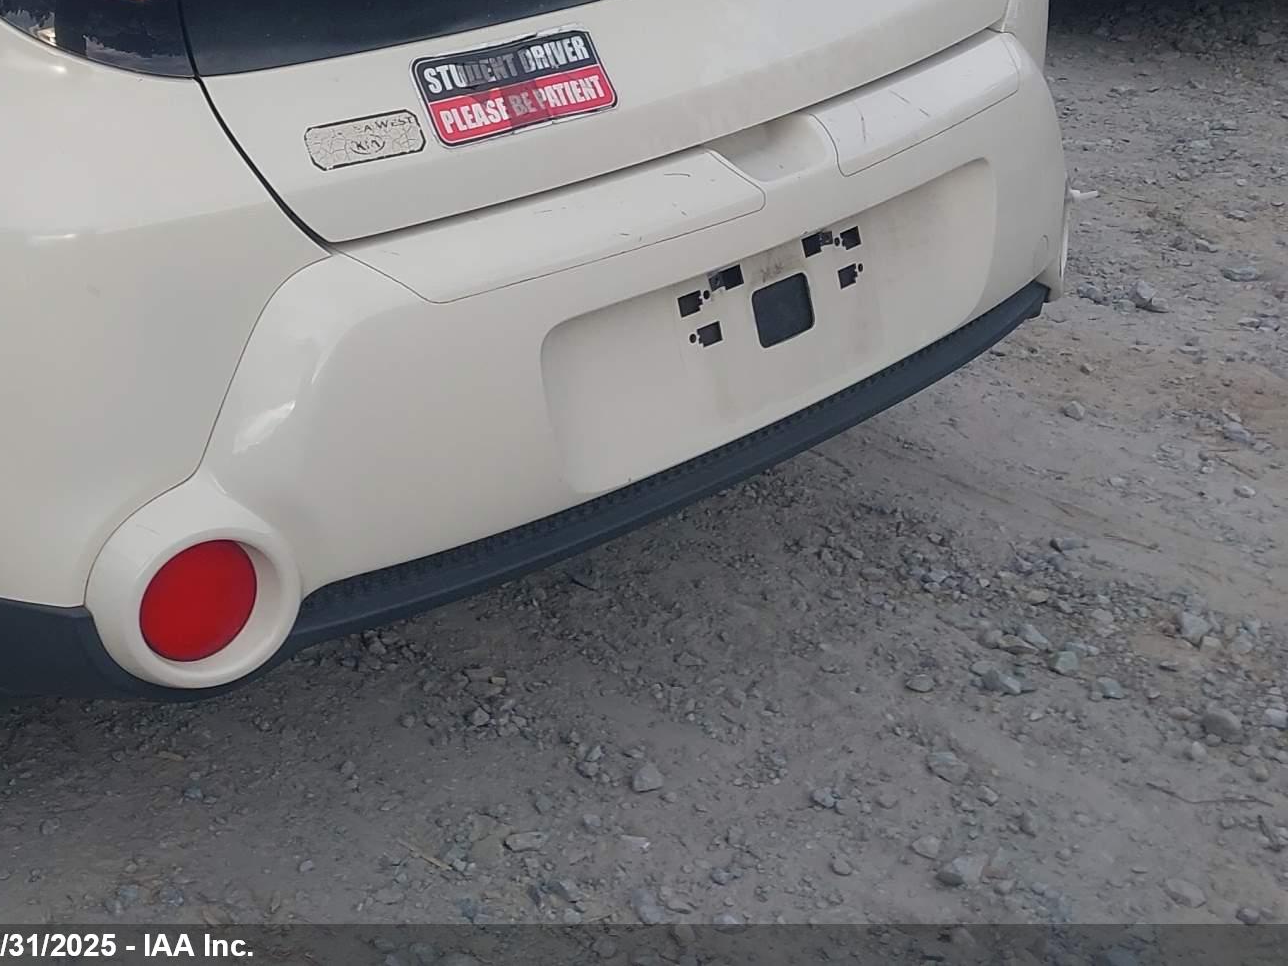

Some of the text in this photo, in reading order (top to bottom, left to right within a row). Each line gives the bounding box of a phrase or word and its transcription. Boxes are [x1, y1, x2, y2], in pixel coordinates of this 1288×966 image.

[423, 35, 590, 94] STUDENT DRIVER
[439, 75, 605, 134] PLEASE BE PATIENT
